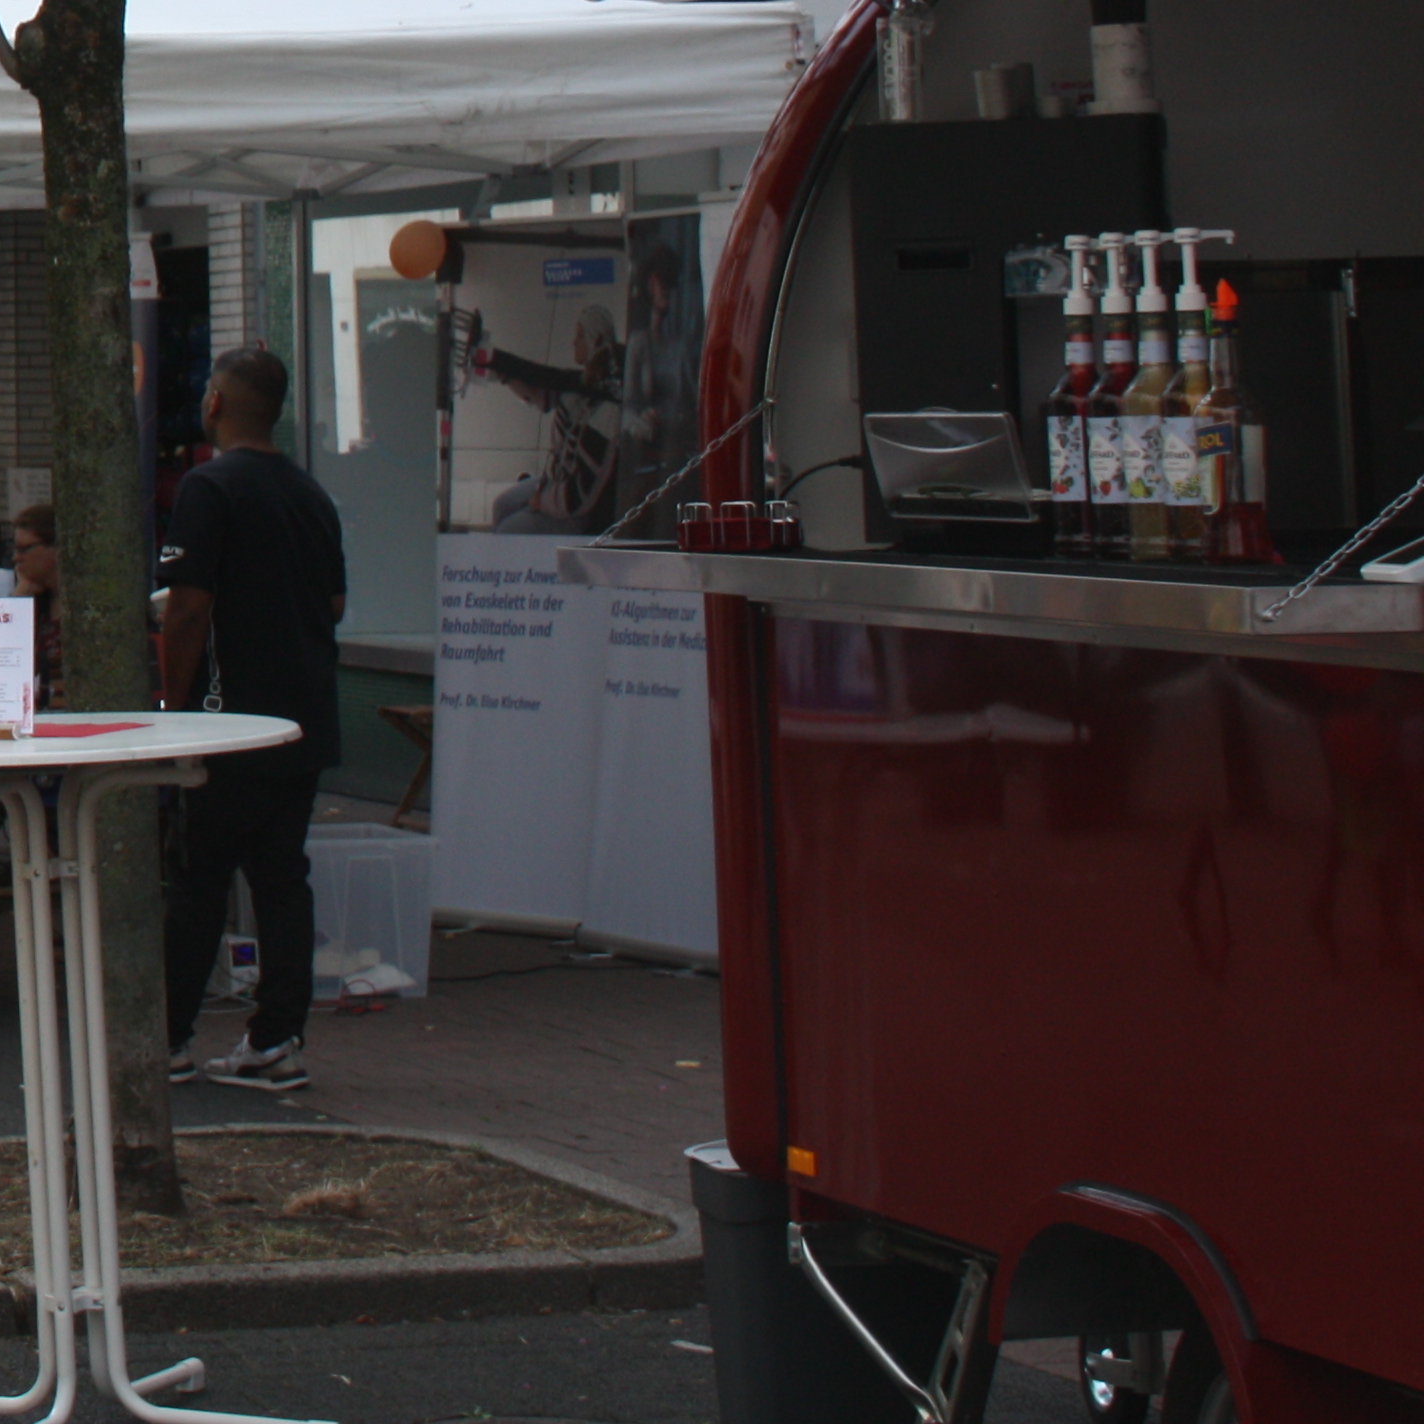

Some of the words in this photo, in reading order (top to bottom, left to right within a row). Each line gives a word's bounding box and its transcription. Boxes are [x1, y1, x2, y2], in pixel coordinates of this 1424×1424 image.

[442, 565, 502, 587] Forschung
[502, 570, 523, 584] zur
[524, 567, 559, 585] Anwe
[441, 595, 462, 608] von
[464, 592, 526, 610] Exoskelett
[528, 593, 540, 610] in
[542, 594, 564, 612] der
[611, 600, 680, 623] KI-Algorithmen
[680, 607, 697, 621] zur
[441, 617, 526, 636] Rehabilitation
[528, 621, 553, 637] und
[609, 627, 650, 646] Assistenz
[651, 629, 660, 646] in
[661, 630, 678, 648] der
[678, 632, 706, 650] Mediz
[441, 642, 506, 664] Raumfahrt
[439, 692, 463, 709] Prof.
[465, 694, 479, 707] Dr.
[500, 696, 541, 711] Kirchner
